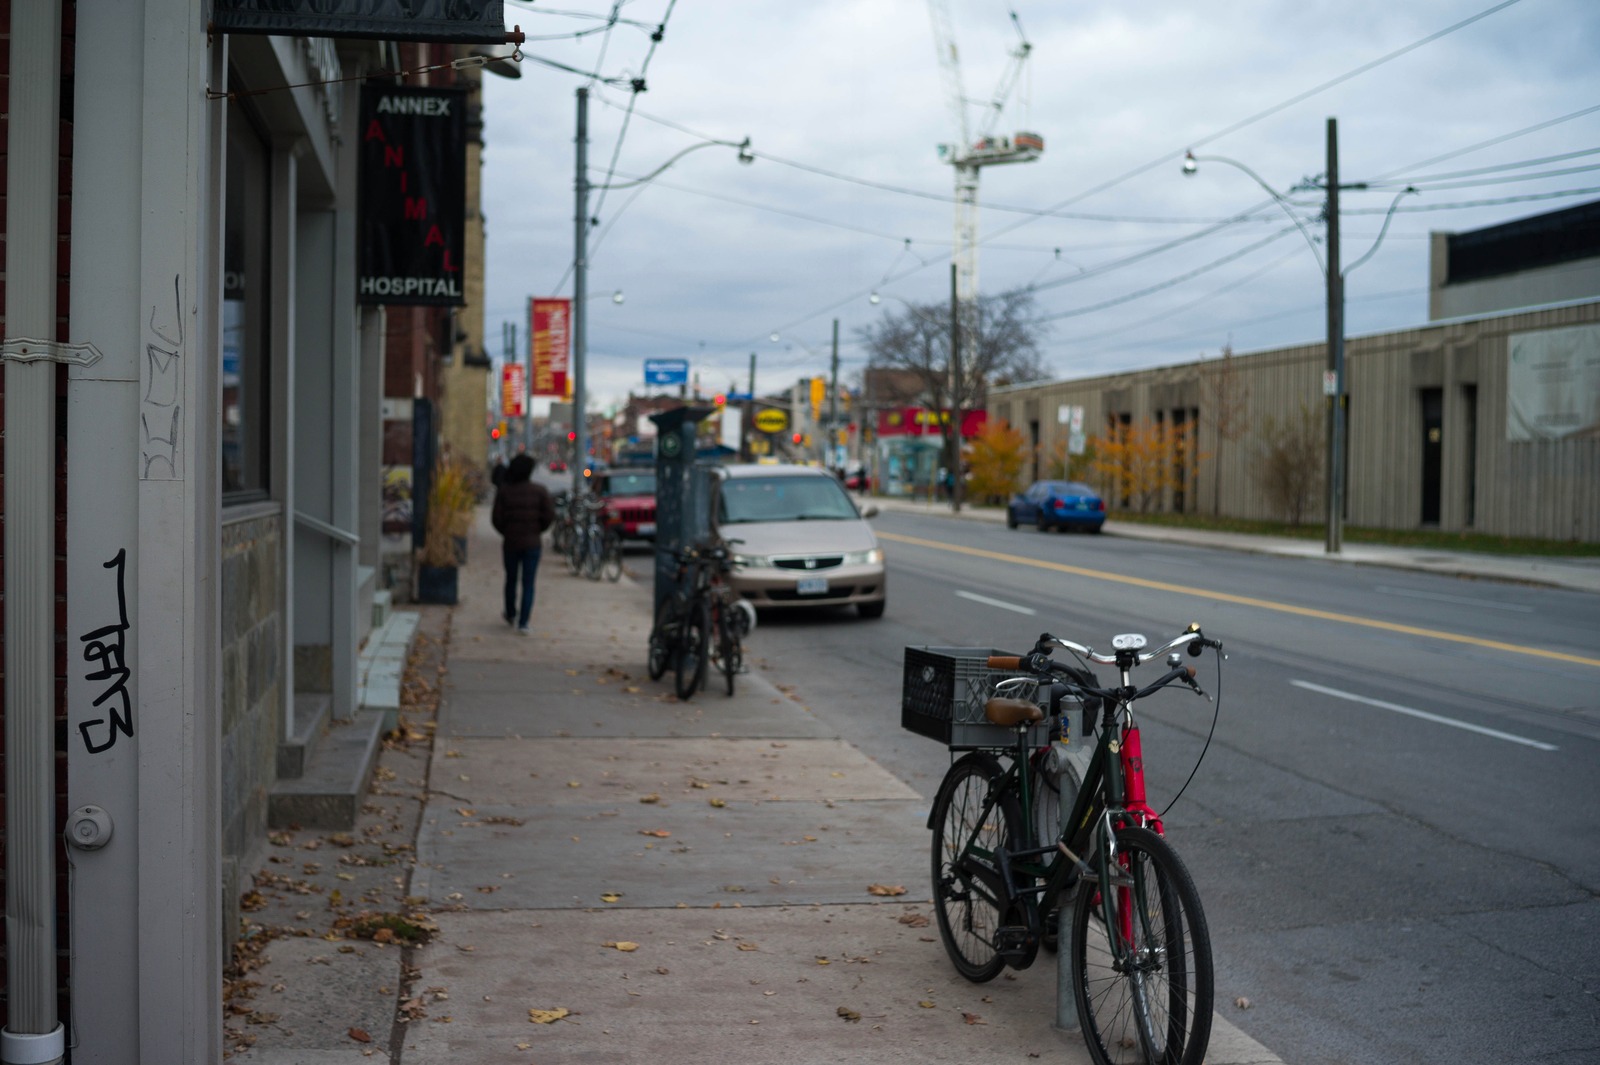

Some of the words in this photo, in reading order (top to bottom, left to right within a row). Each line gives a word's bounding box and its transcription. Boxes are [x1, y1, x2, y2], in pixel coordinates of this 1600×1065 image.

[377, 96, 451, 116] ANNEX
[365, 119, 459, 272] ANIMAL
[360, 277, 460, 297] HOSPITAL
